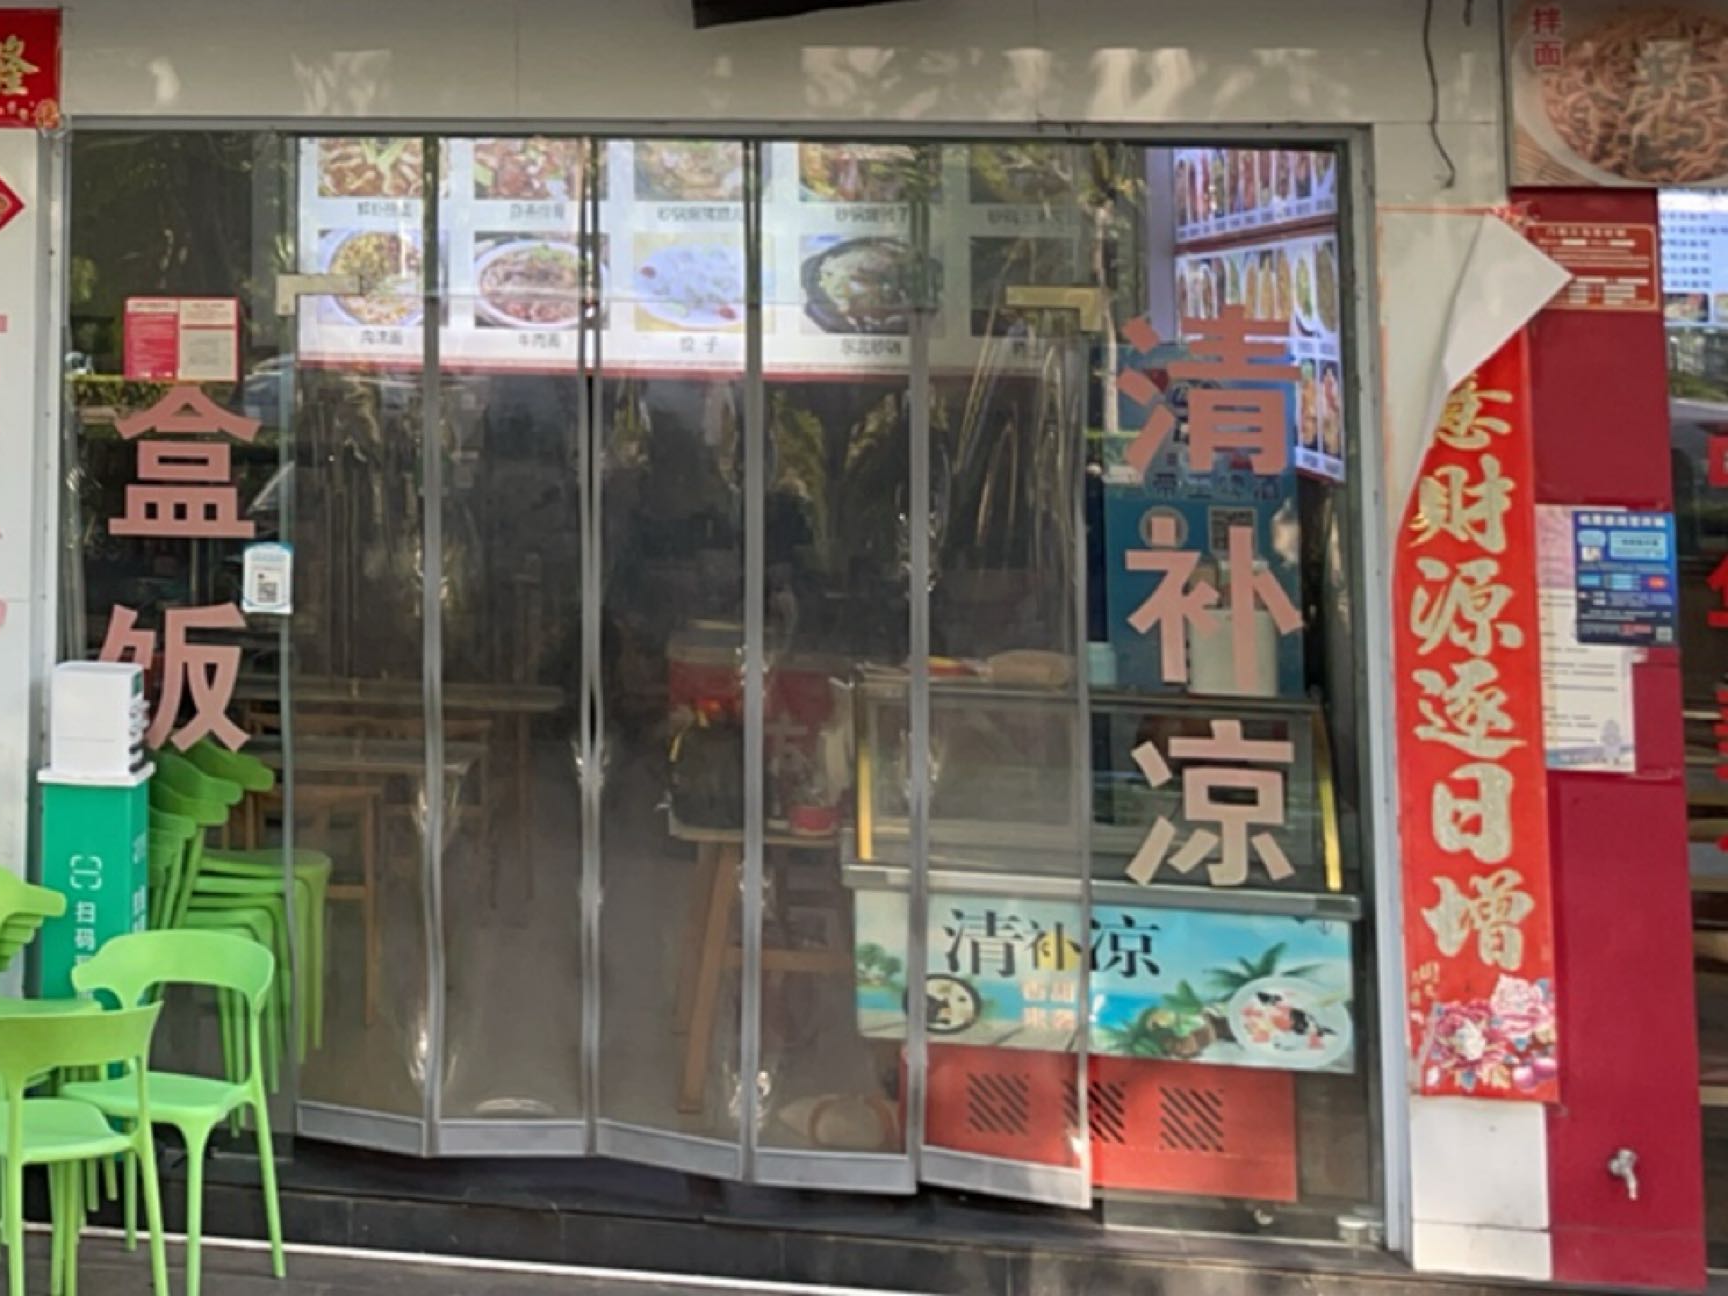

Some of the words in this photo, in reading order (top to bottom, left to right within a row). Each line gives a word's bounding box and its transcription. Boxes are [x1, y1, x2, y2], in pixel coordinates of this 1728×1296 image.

[98, 386, 263, 753] 盒饭
[1116, 304, 1305, 886] 清补凉
[941, 907, 1162, 979] 清补凉
